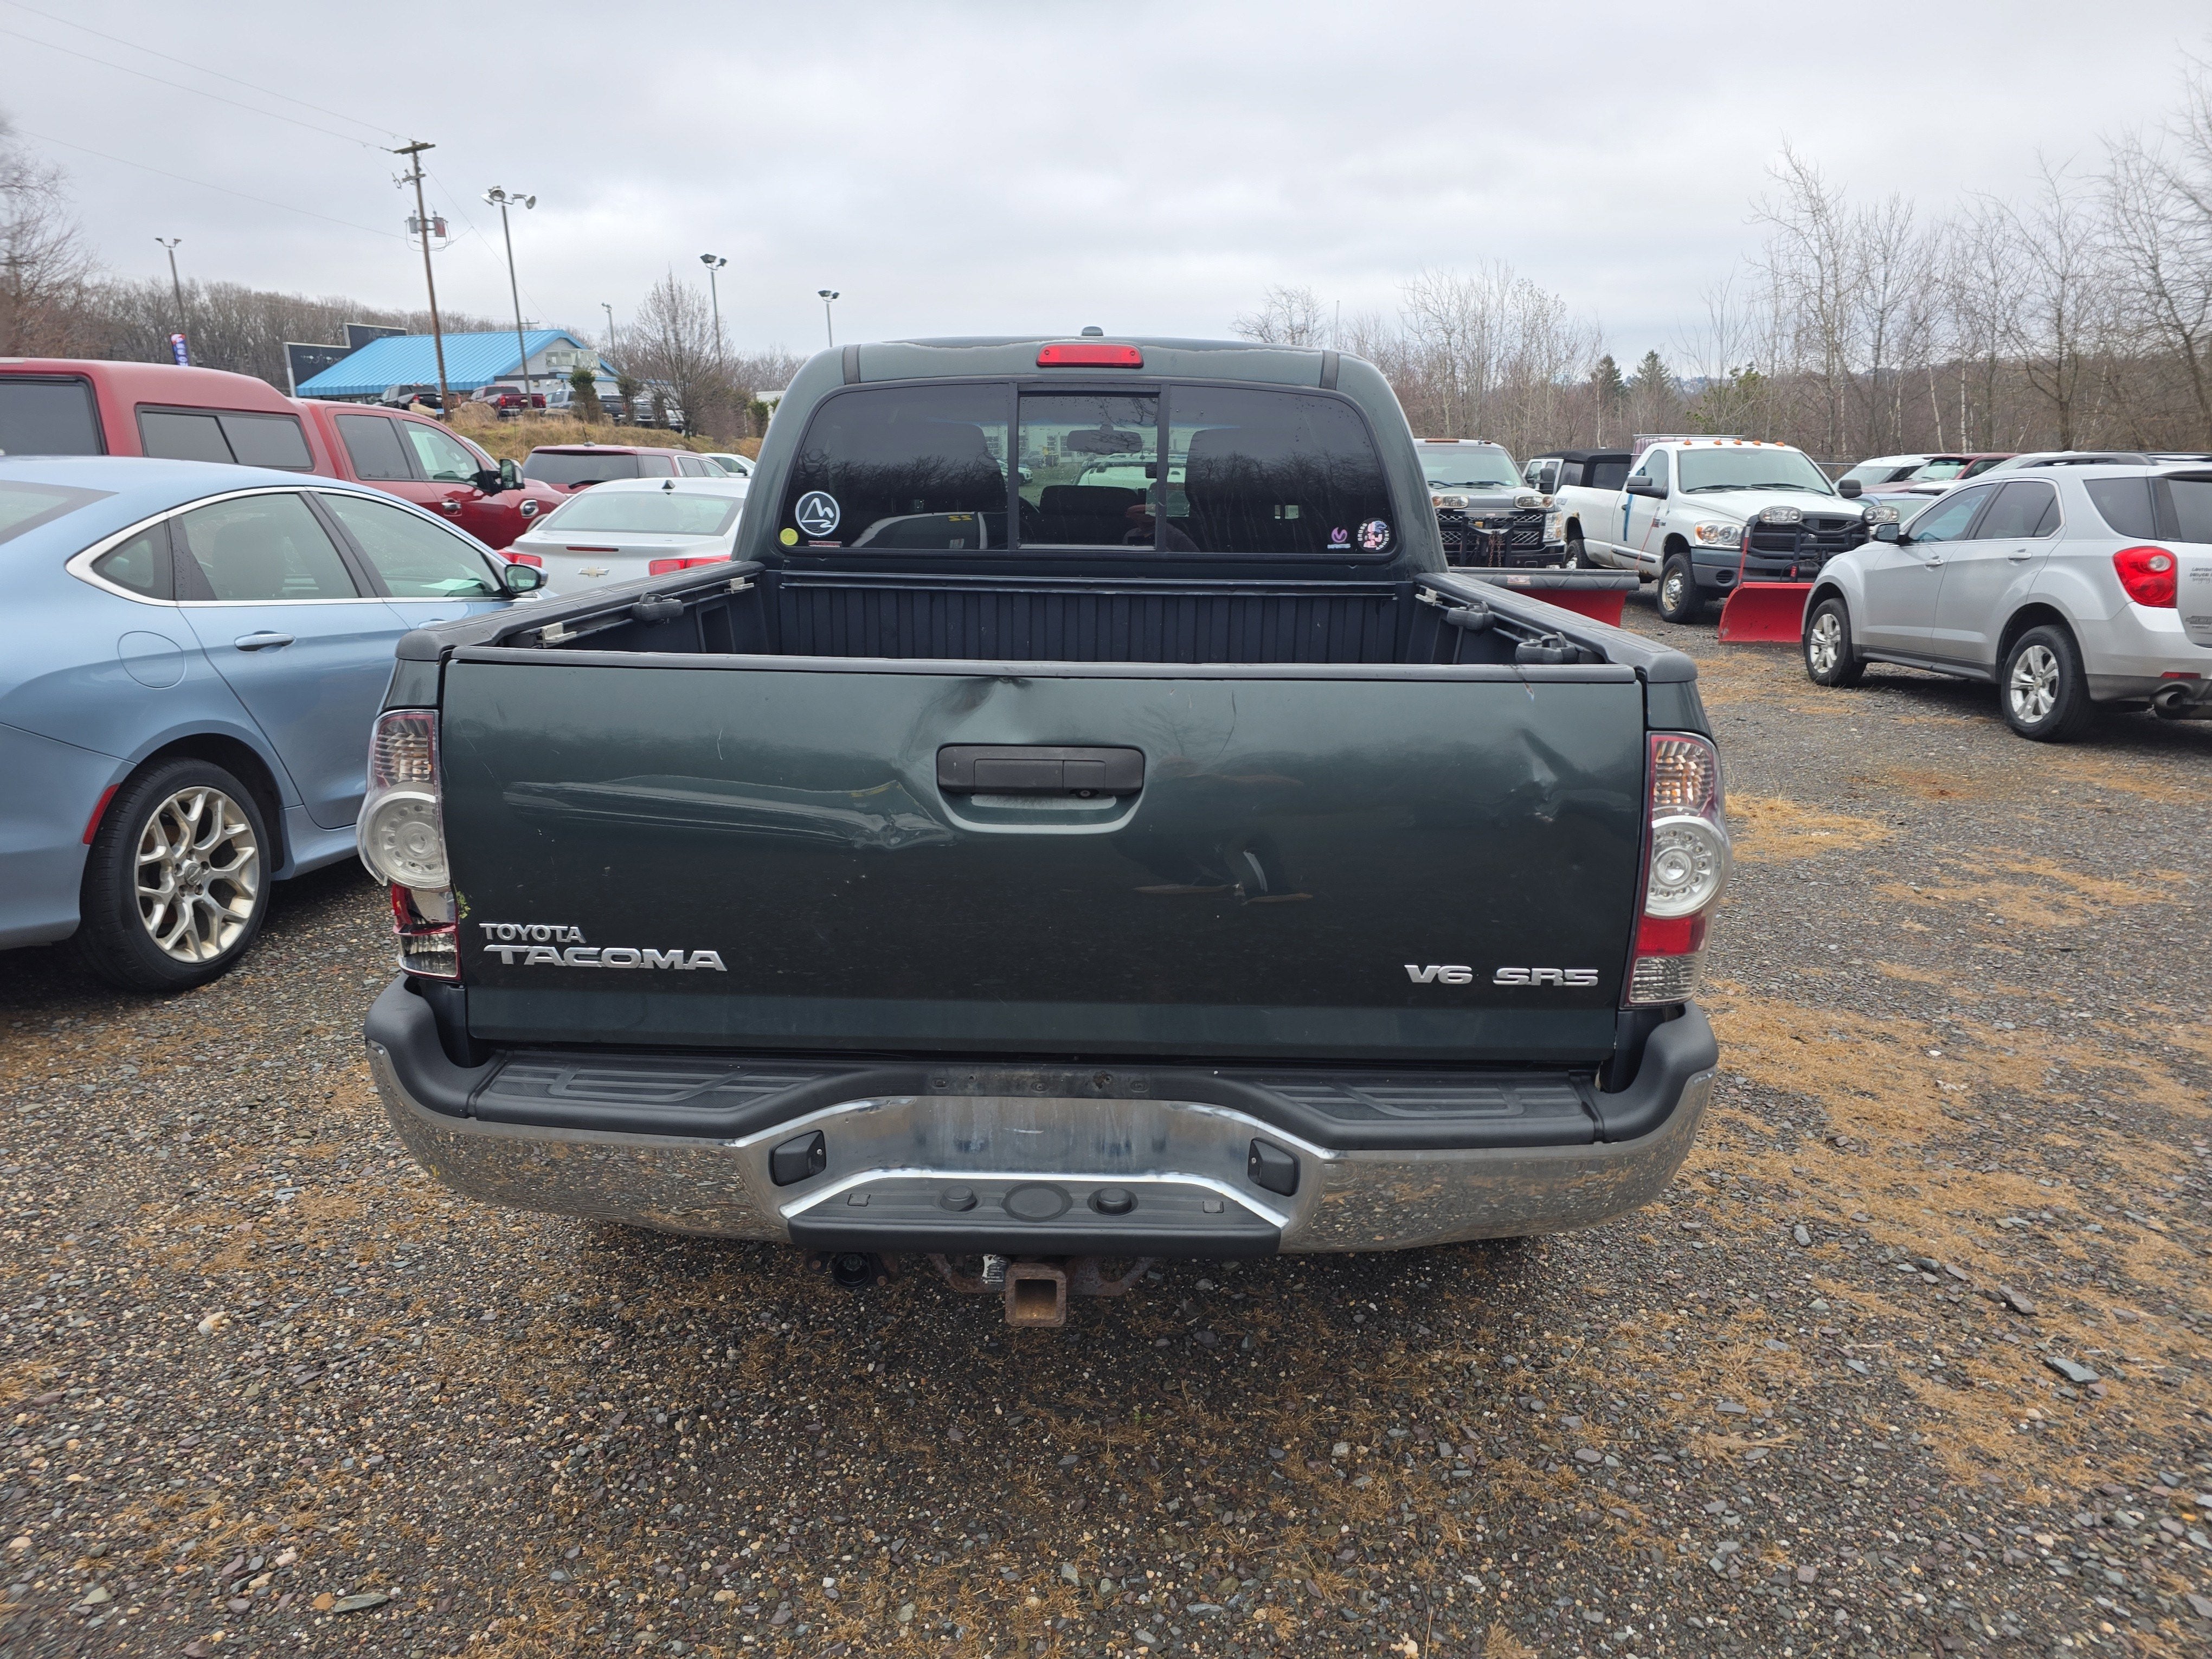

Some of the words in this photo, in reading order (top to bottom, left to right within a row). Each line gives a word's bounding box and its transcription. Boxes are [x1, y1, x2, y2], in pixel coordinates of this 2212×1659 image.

[479, 923, 587, 943] TOYOTA
[484, 944, 728, 972] TACOMA
[1404, 964, 1473, 984] V6
[1493, 967, 1599, 986] SR5
